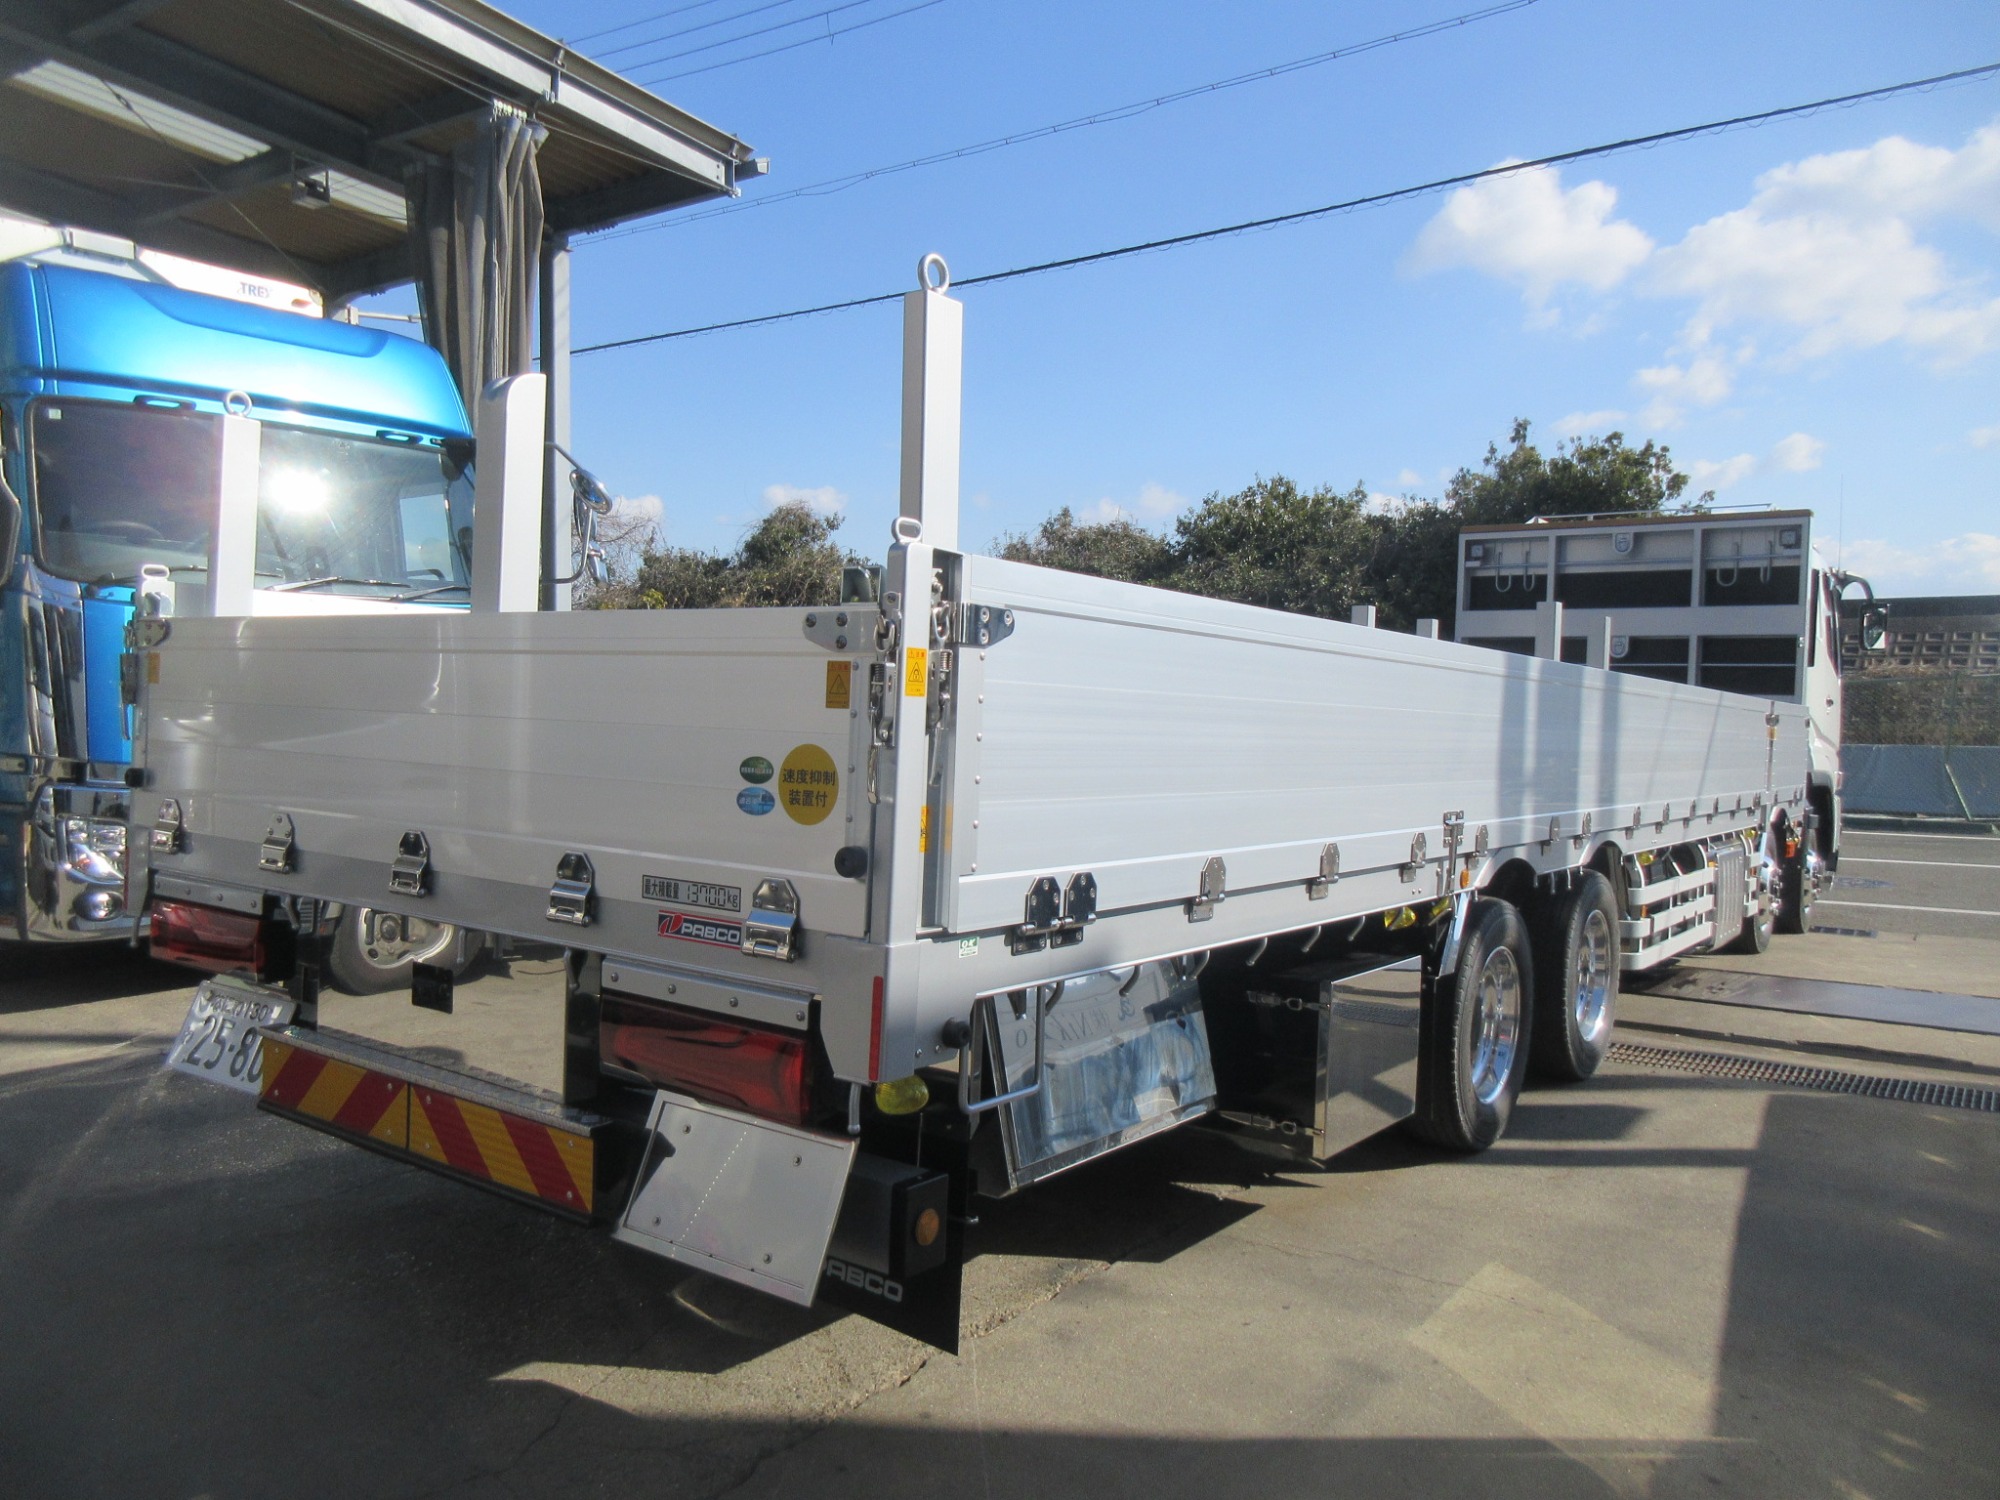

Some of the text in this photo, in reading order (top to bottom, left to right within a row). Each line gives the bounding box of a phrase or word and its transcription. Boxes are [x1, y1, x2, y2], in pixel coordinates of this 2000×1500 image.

[782, 768, 836, 786] 速度抑制
[788, 789, 828, 808] 装置付
[681, 922, 740, 943] PABCO
[823, 1259, 903, 1302] ABCO
